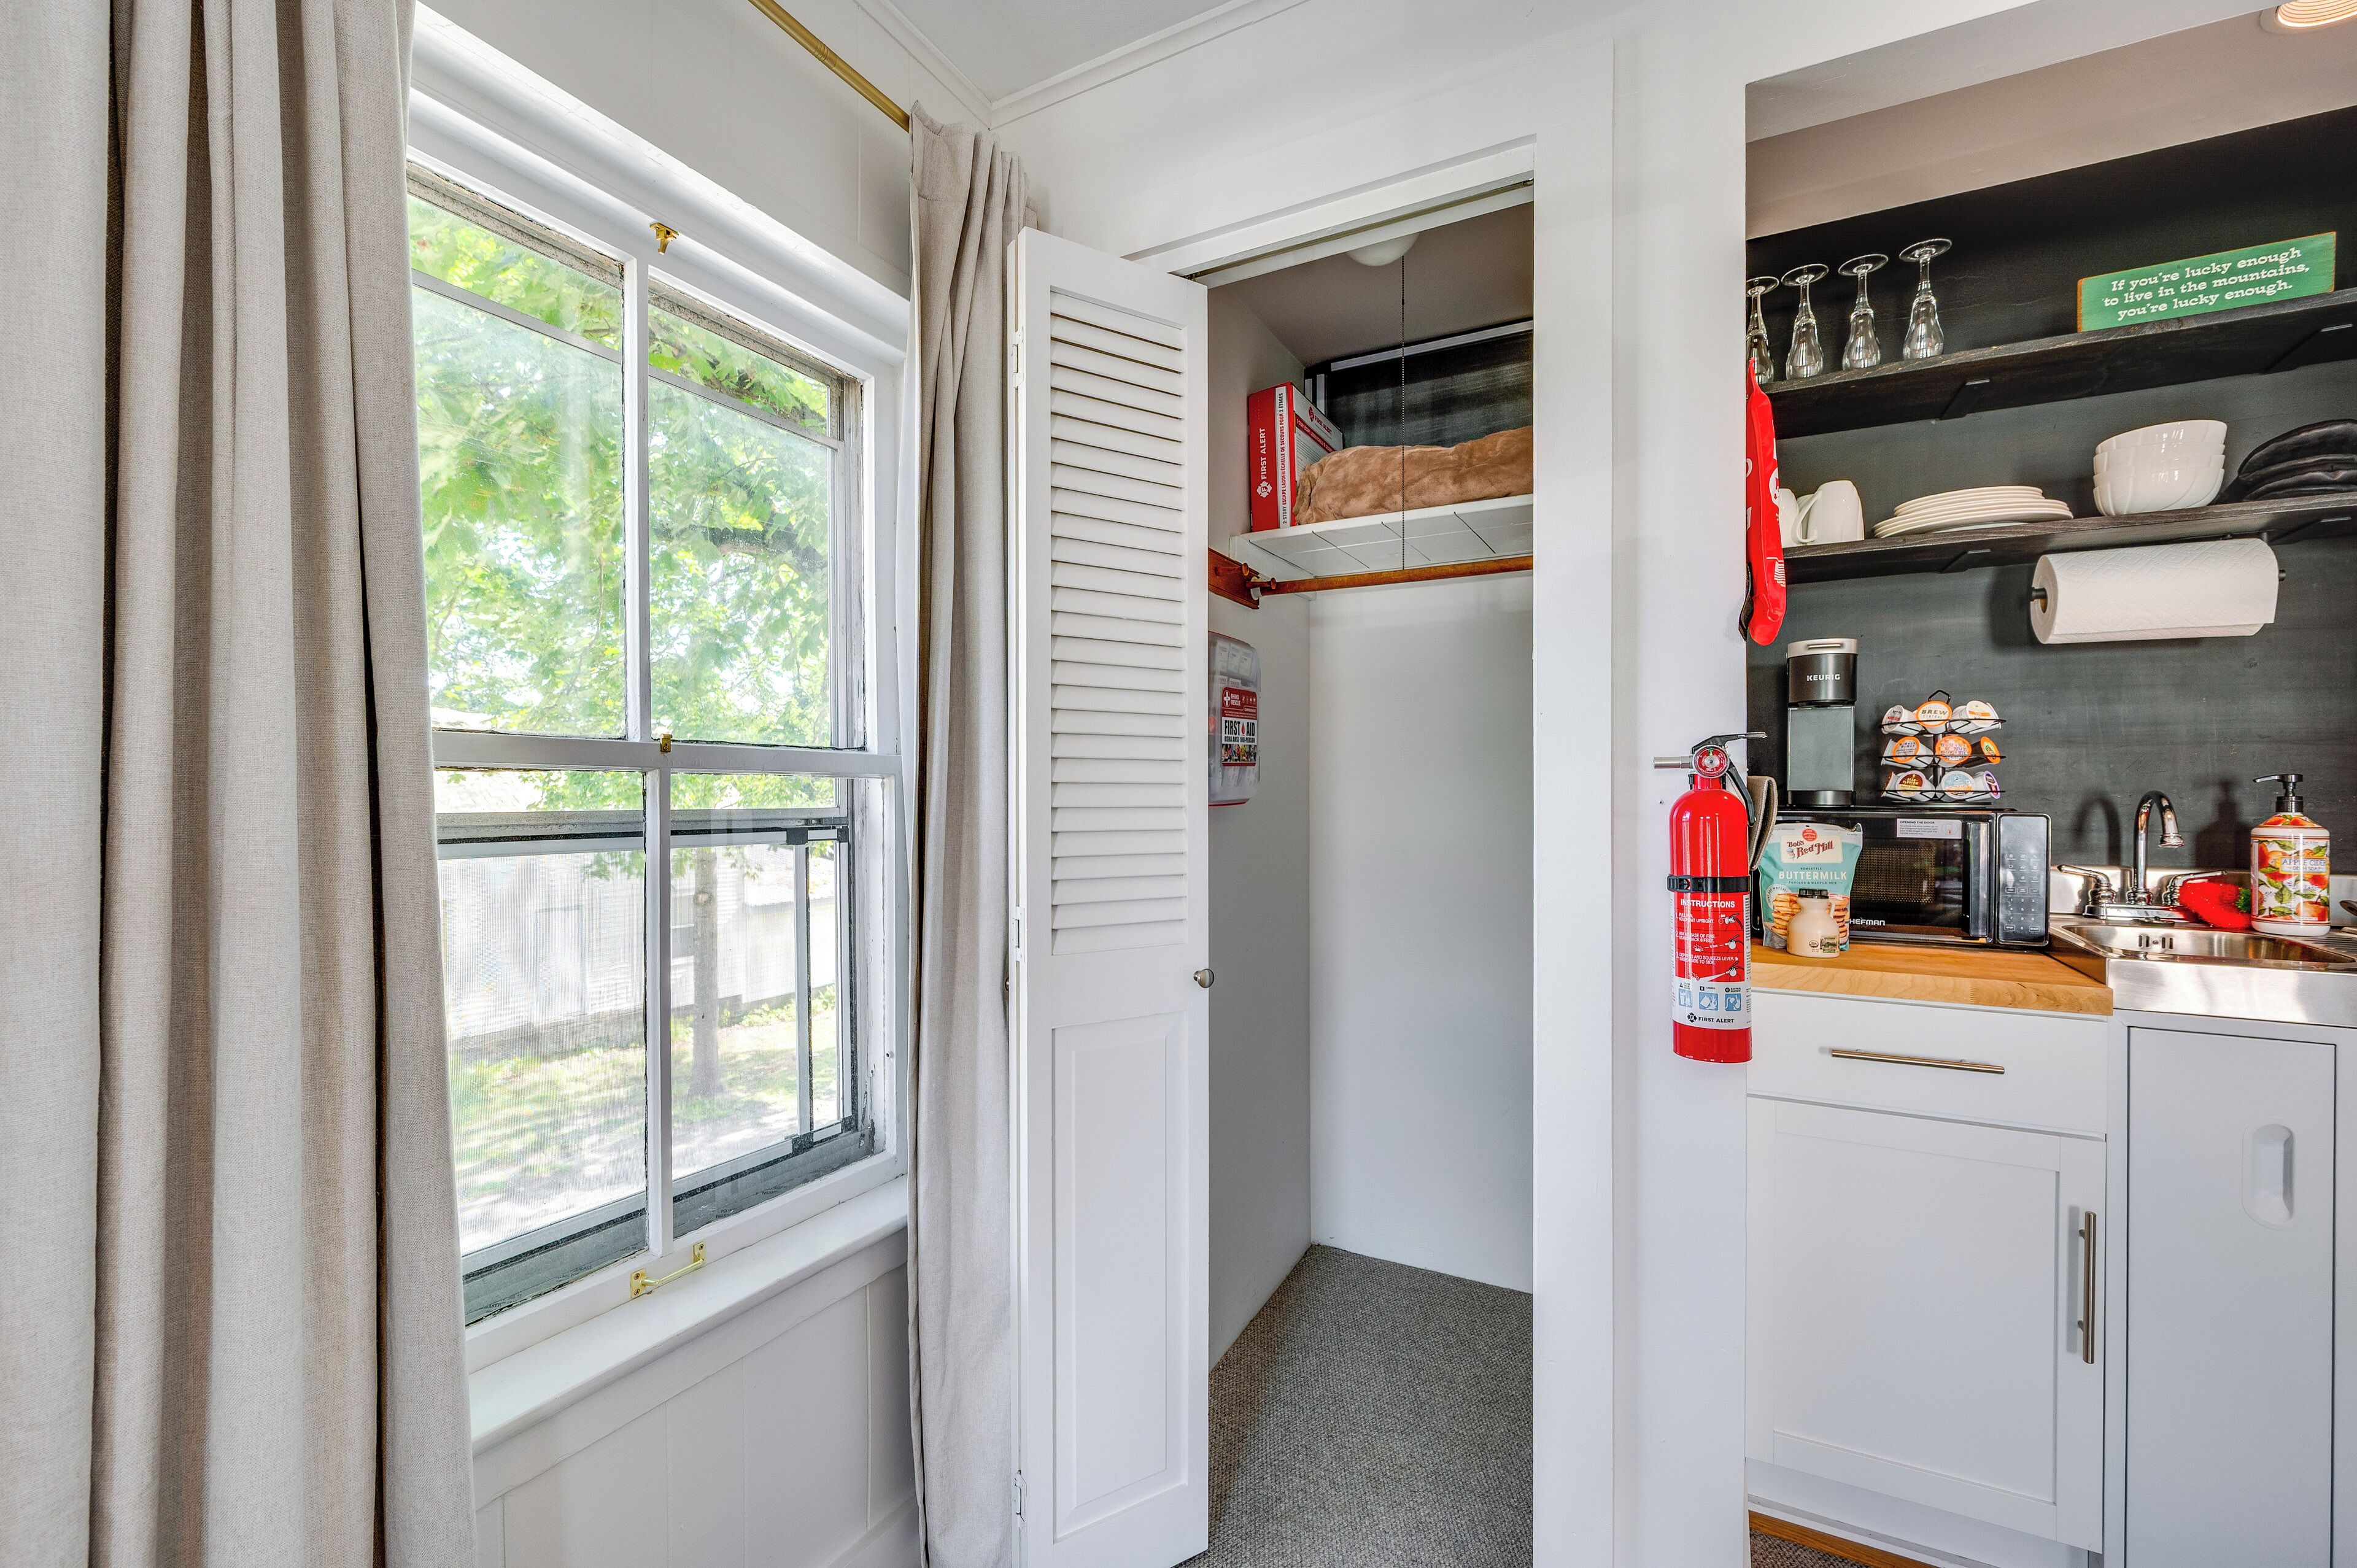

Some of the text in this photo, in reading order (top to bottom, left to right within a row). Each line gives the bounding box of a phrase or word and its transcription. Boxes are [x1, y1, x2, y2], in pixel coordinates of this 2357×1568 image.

[2111, 247, 2302, 292] If you're lucky enough
[2103, 262, 2310, 307] to live in the mountains,
[2118, 279, 2293, 322] you're lucky enough.
[1225, 720, 1255, 736] FIRST AID
[1797, 840, 1833, 859] Red Mill
[1779, 871, 1847, 880] BUTTERMILK
[1681, 898, 1735, 908] INSTRUCTIONS
